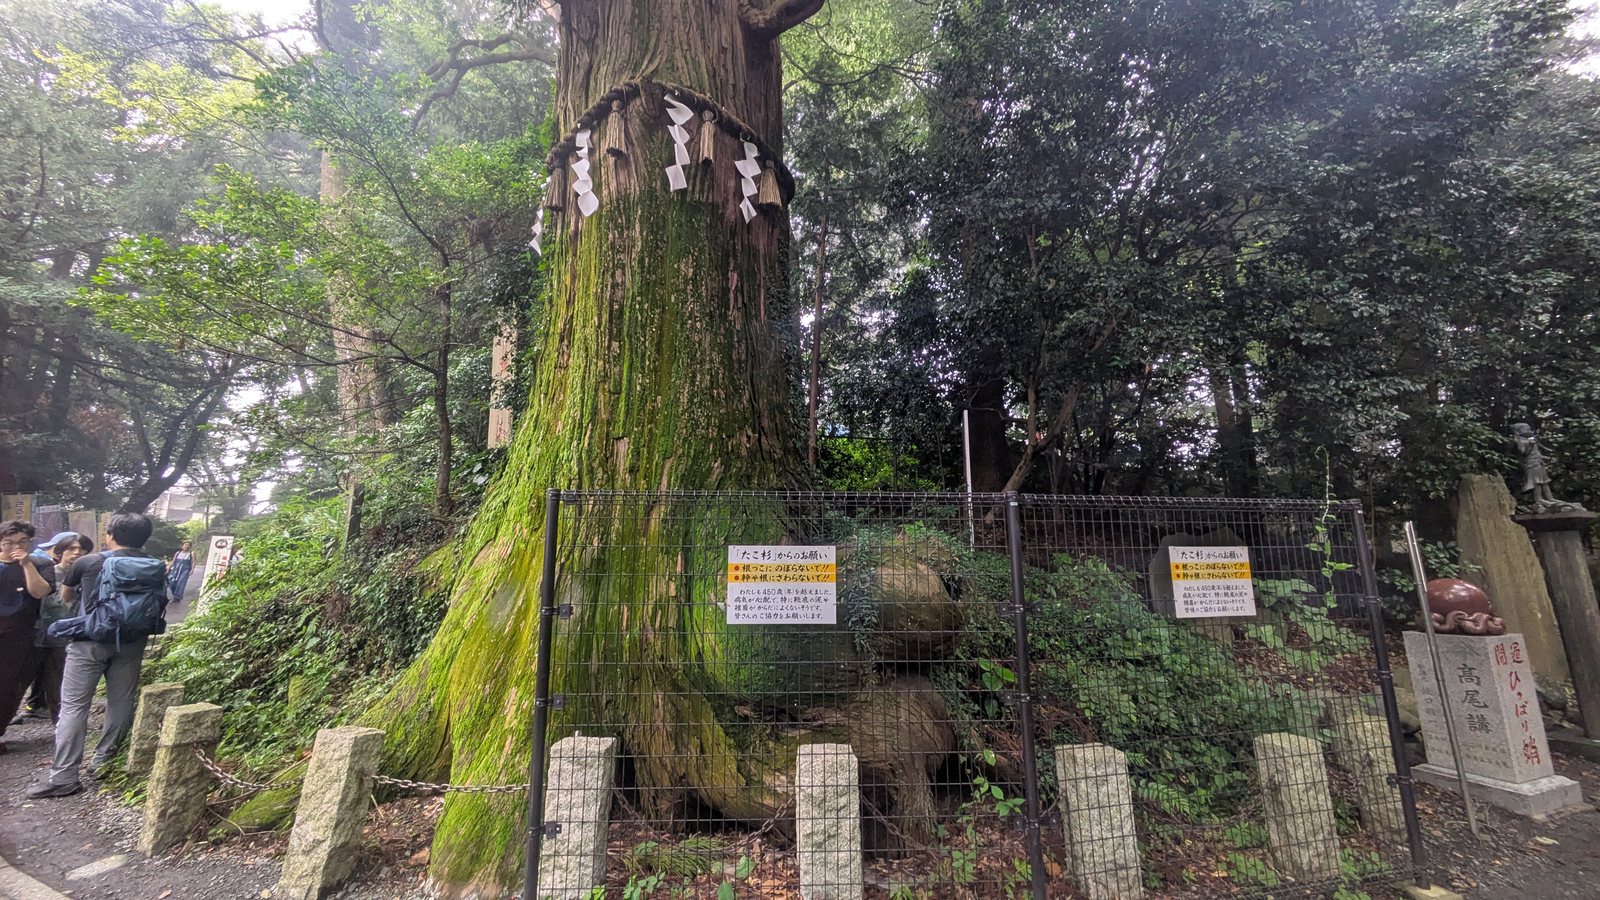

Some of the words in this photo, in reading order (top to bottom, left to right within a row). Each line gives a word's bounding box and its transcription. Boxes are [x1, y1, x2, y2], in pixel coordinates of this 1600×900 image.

[736, 549, 828, 561] 「たこ杉」からのお願い
